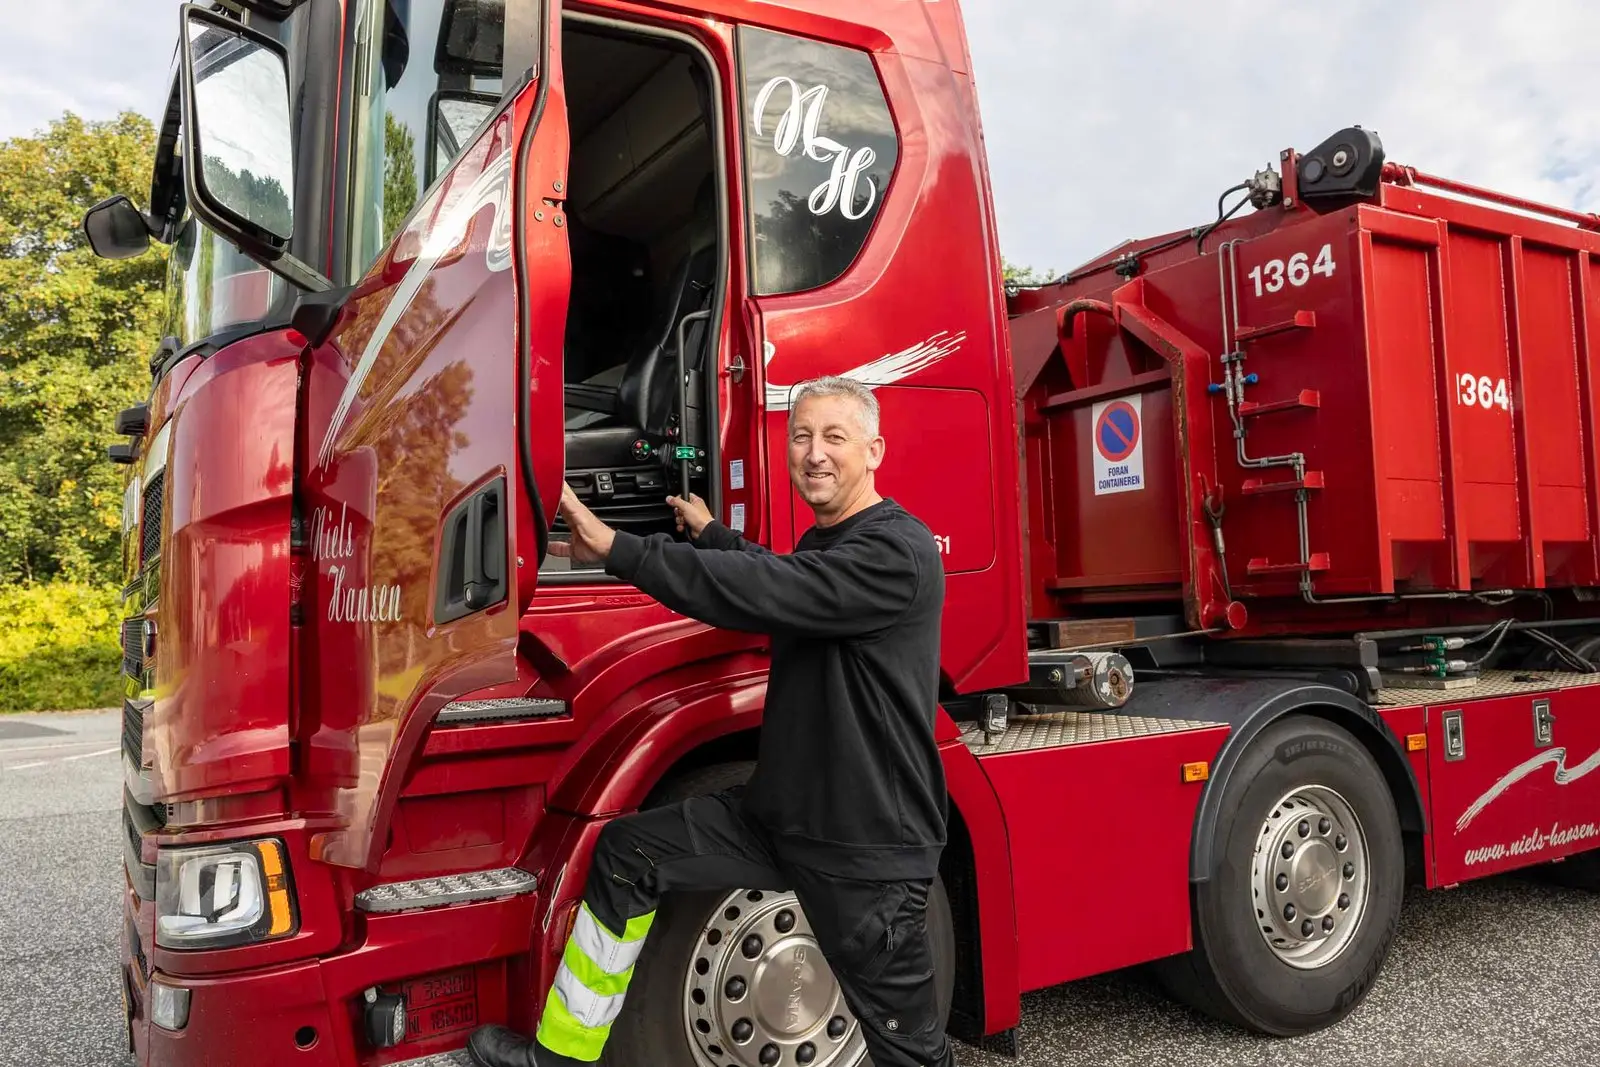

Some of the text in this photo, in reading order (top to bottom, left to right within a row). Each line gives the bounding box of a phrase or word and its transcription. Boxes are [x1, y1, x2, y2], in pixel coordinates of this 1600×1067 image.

[1248, 243, 1336, 297] 1364
[1098, 475, 1140, 490] CONTAINEREN
[1108, 465, 1129, 477] FORAN
[309, 500, 354, 562] Niels
[327, 564, 402, 622] Hansen
[1464, 821, 1600, 866] www.niels-hansen.
